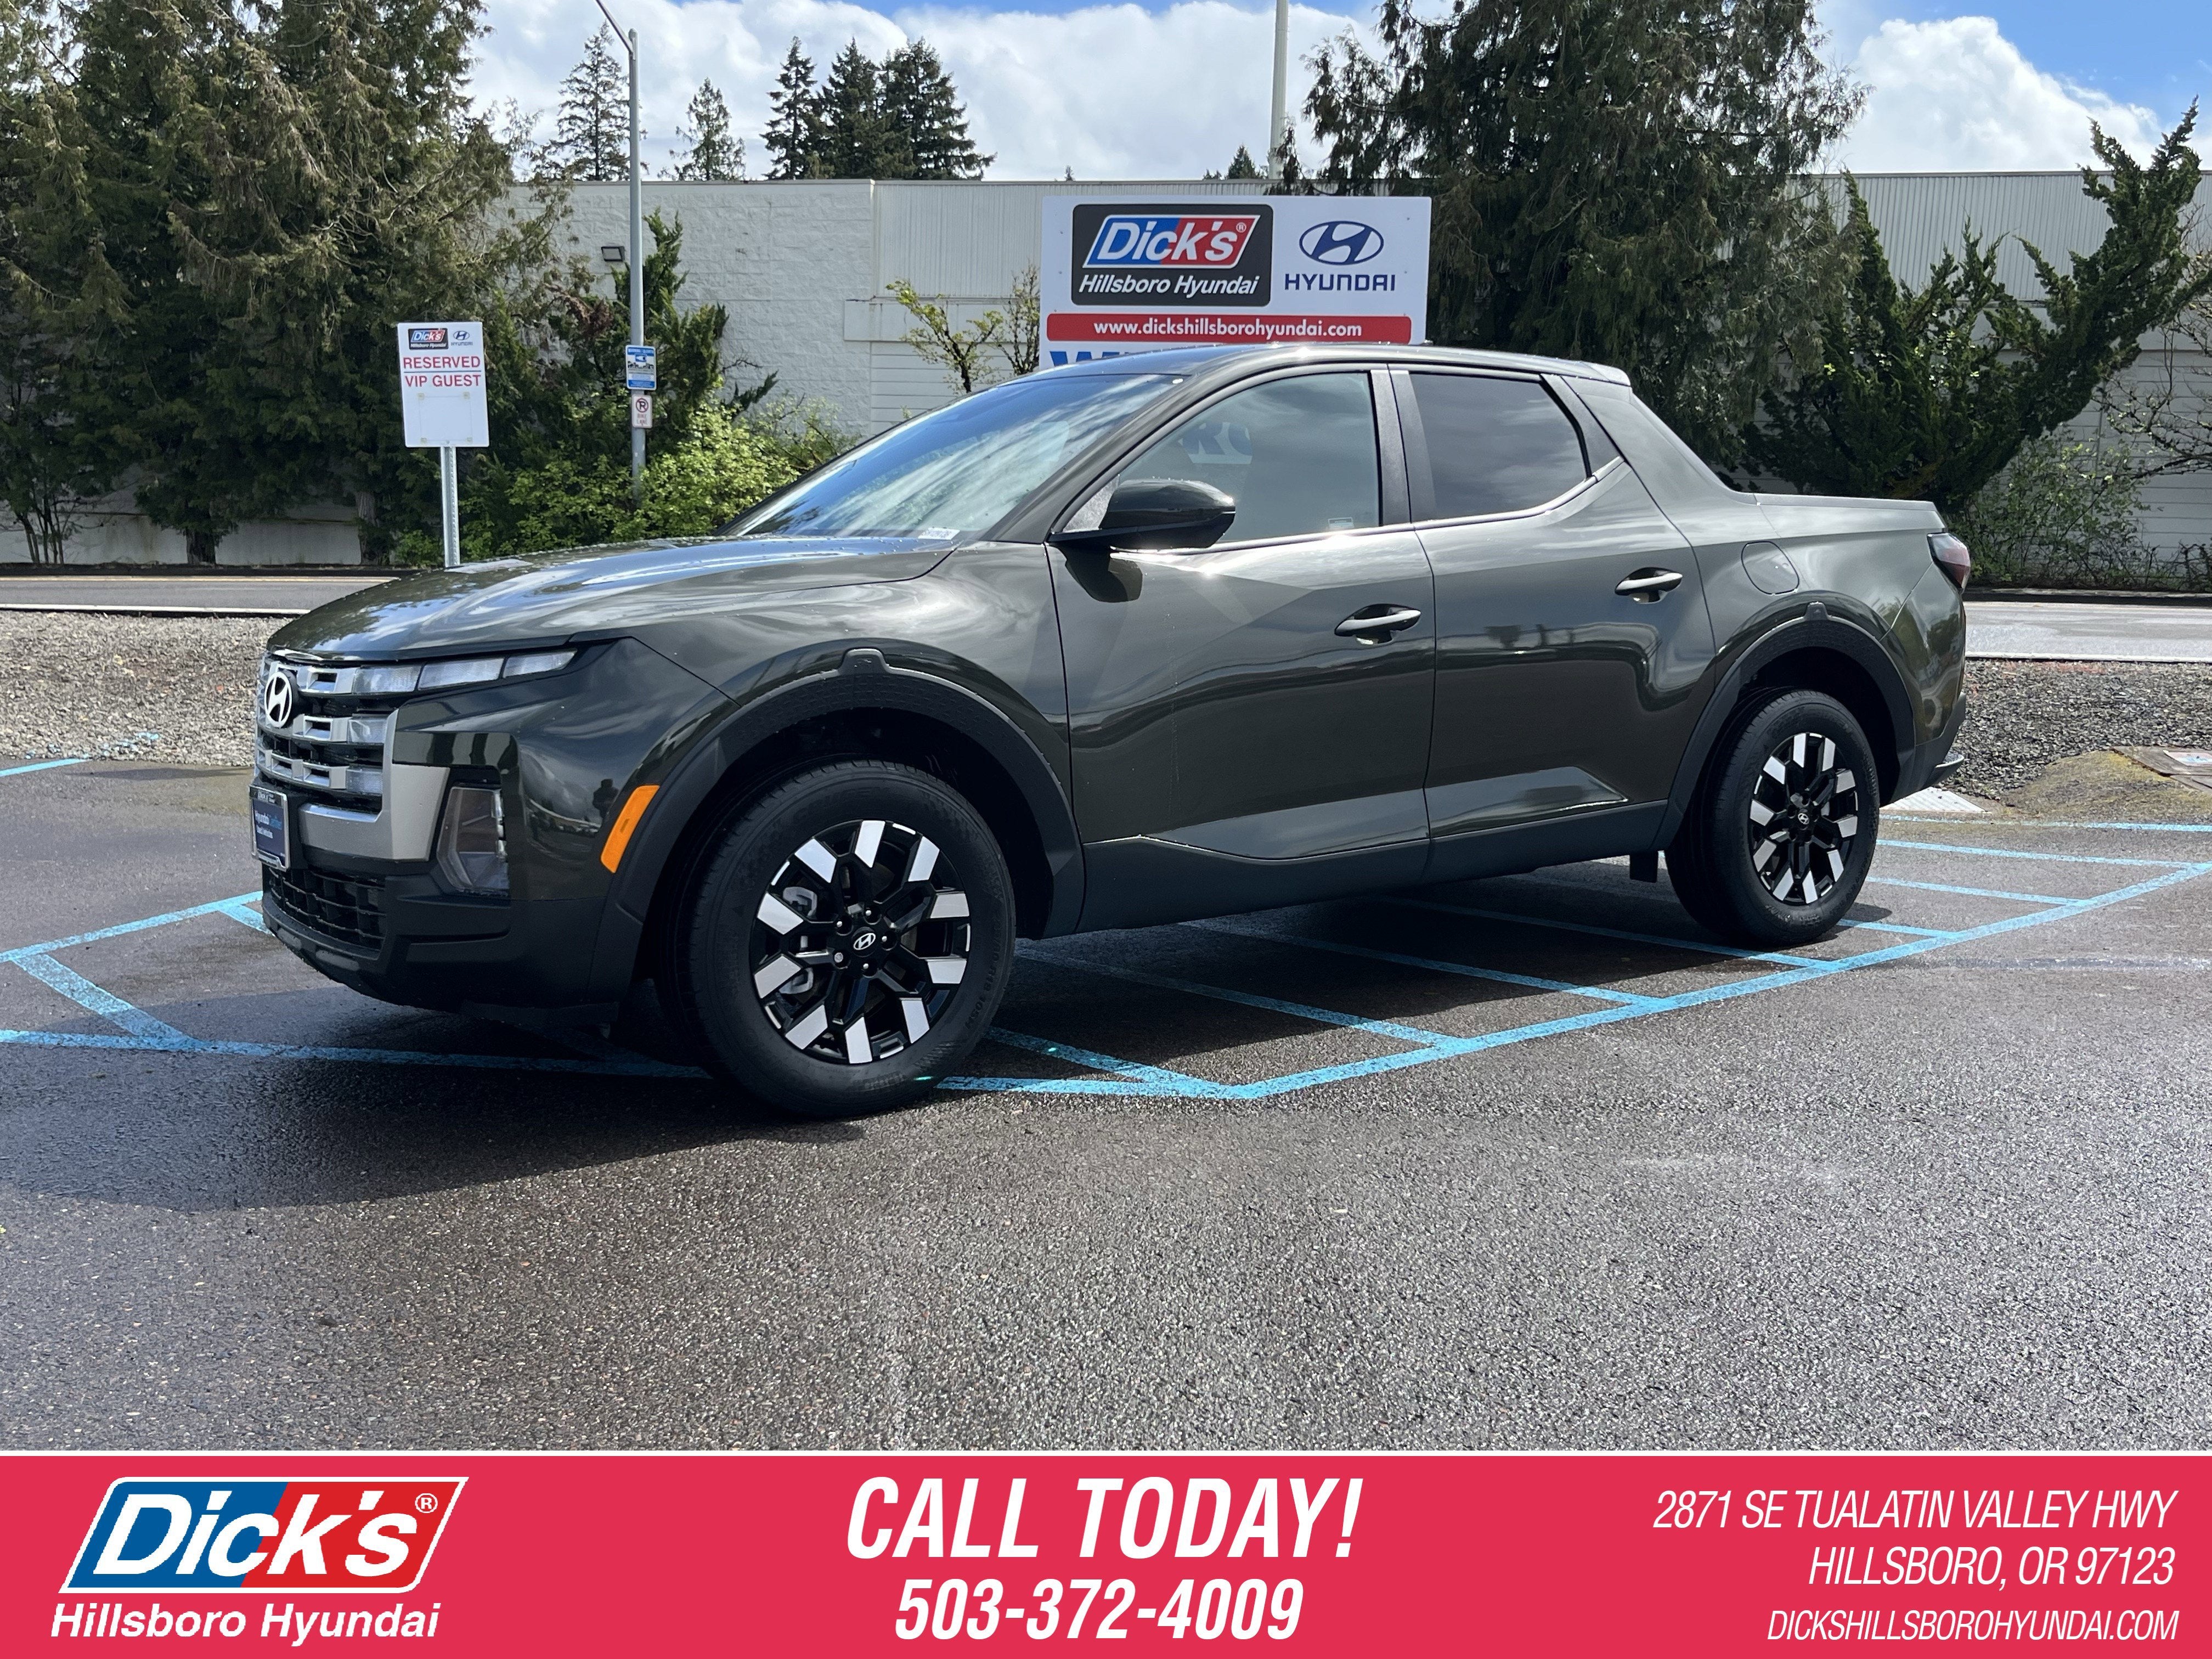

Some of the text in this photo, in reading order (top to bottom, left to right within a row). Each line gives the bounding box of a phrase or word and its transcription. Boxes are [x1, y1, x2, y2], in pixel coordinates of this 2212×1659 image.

[1097, 221, 1238, 262] Dick's
[1079, 274, 1260, 298] Hillsboro Hyundai
[1284, 273, 1396, 291] HYUNDAI
[1093, 316, 1362, 340] www.dickshillsborohyundai.com
[403, 356, 481, 369] RESERVED
[405, 375, 481, 387] VIP GUEST
